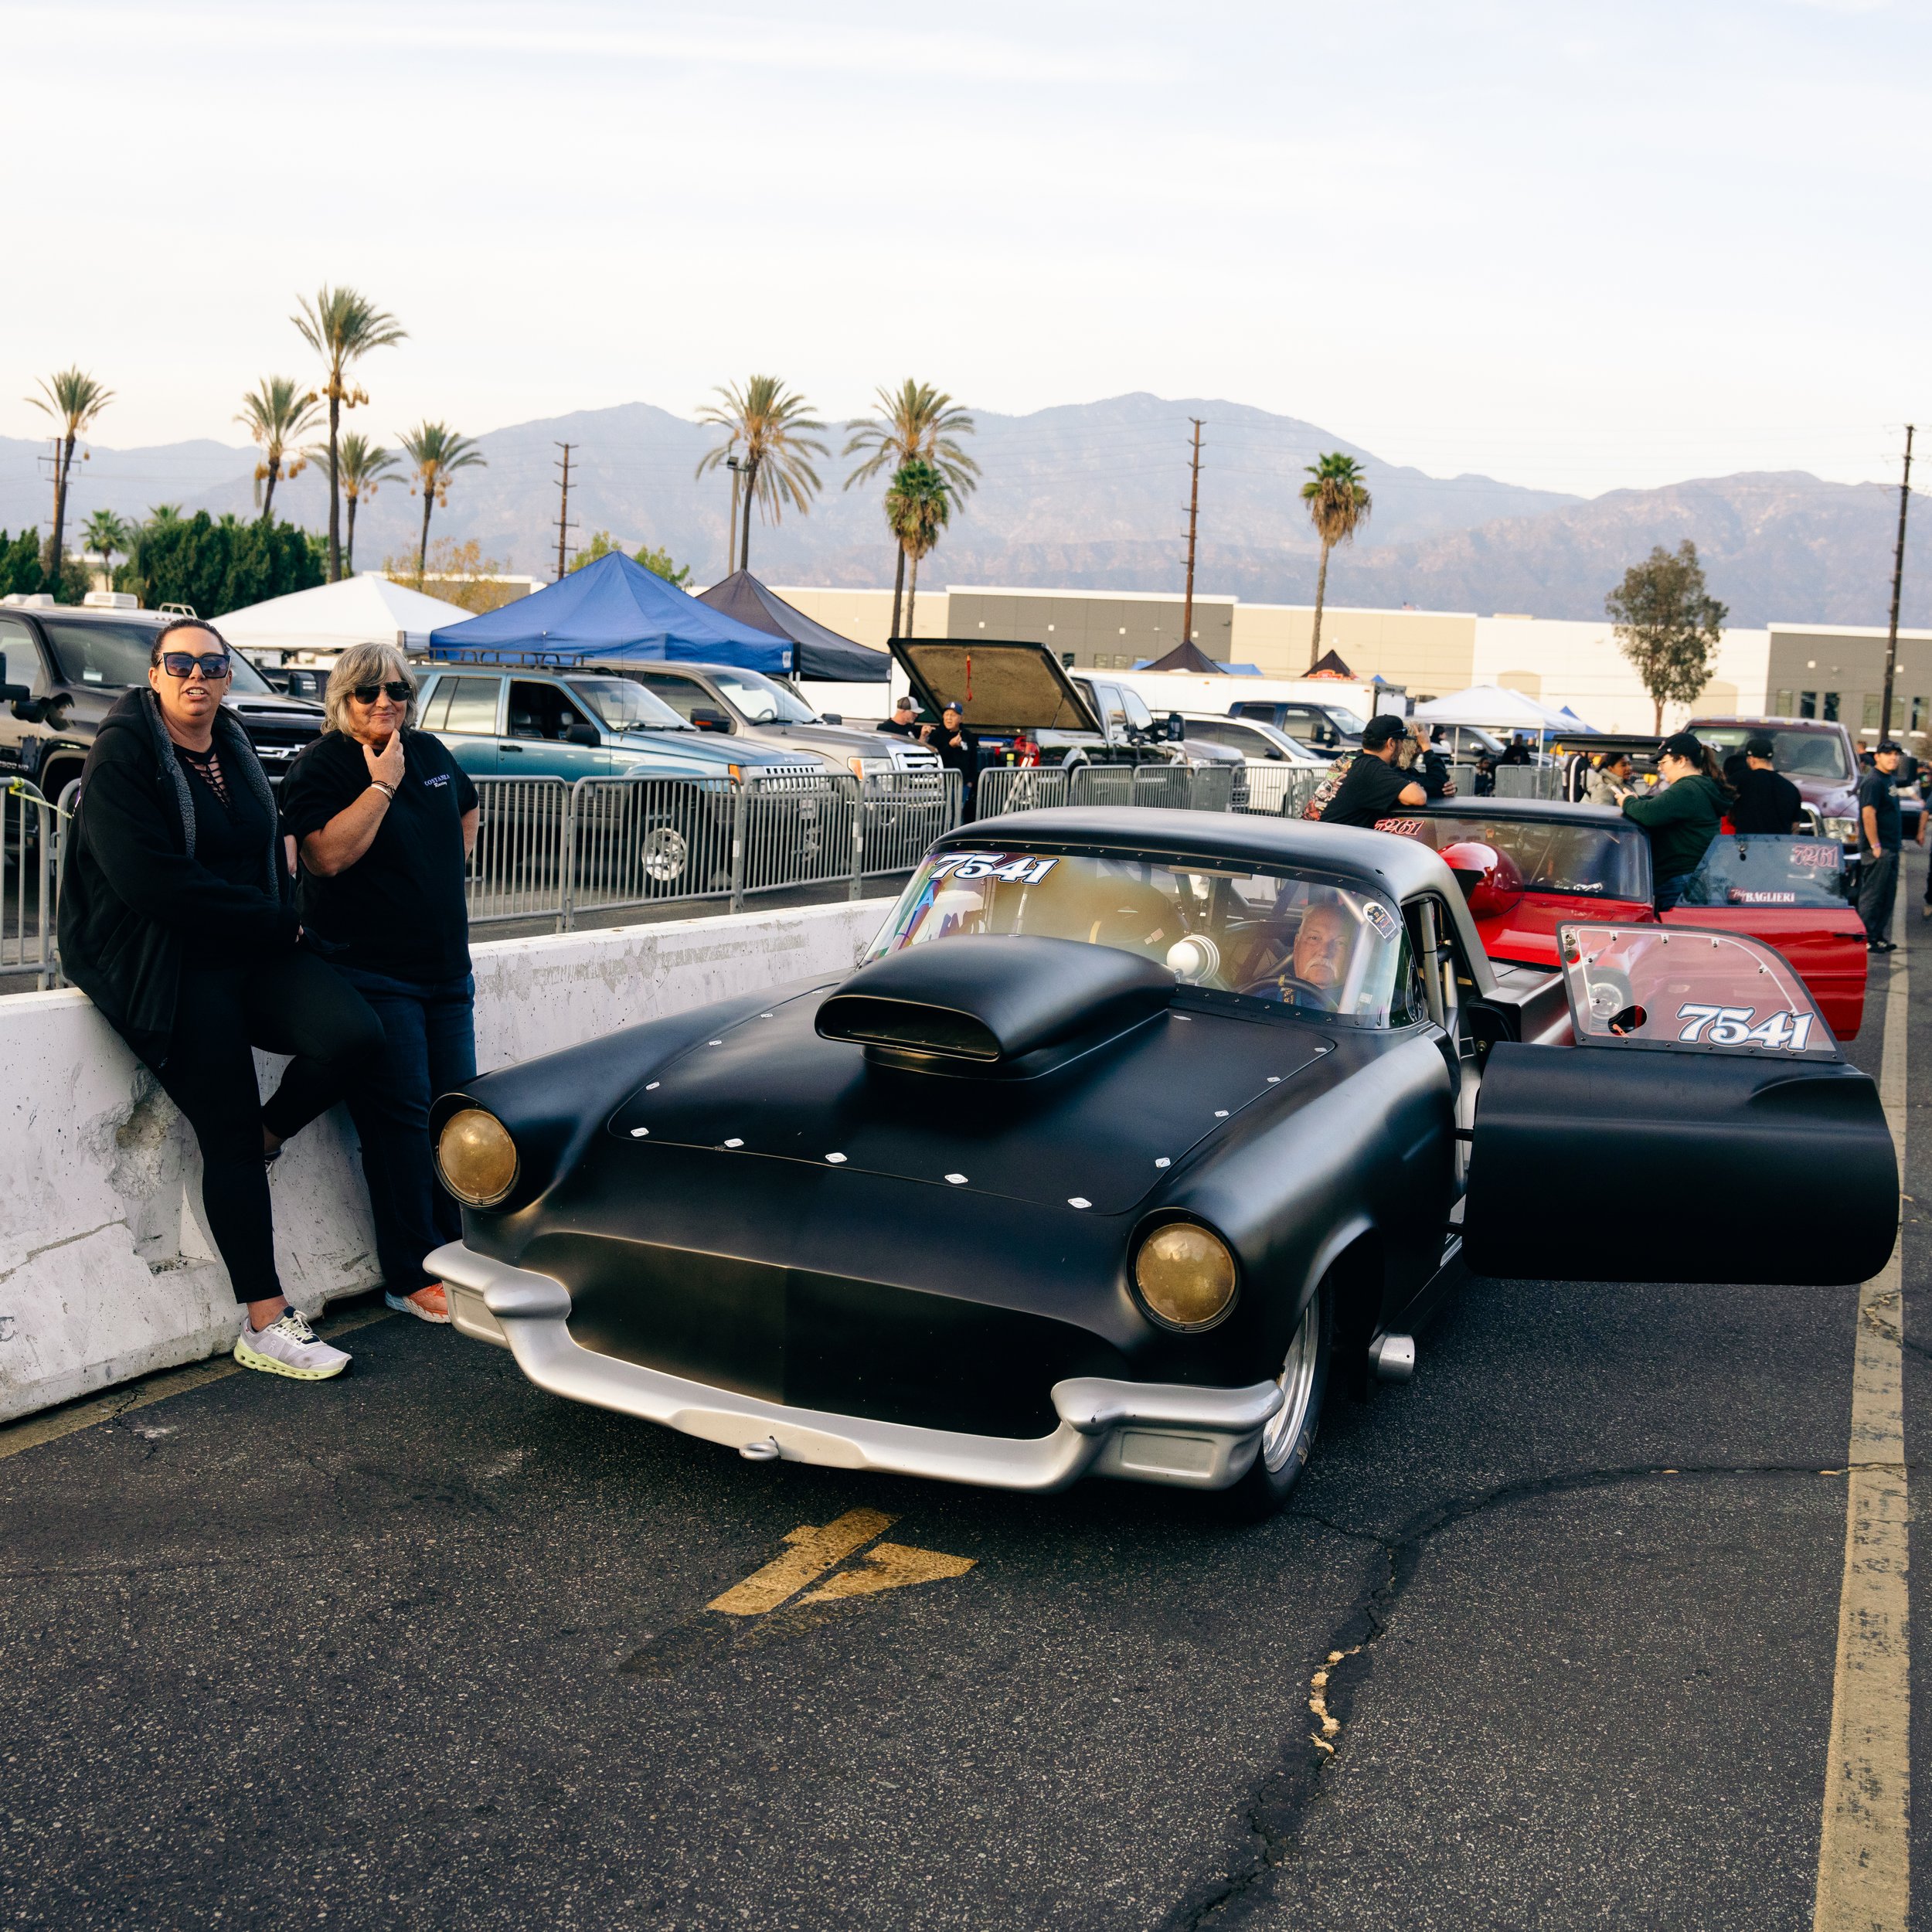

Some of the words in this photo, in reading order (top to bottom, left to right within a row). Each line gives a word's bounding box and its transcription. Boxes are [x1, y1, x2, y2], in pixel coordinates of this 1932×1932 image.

[1374, 819, 1425, 835] 7261
[1793, 843, 1838, 868] 7261
[928, 852, 1060, 886] 7541
[1745, 892, 1795, 903] BAGLIERI
[1675, 1002, 1815, 1052] 7541
